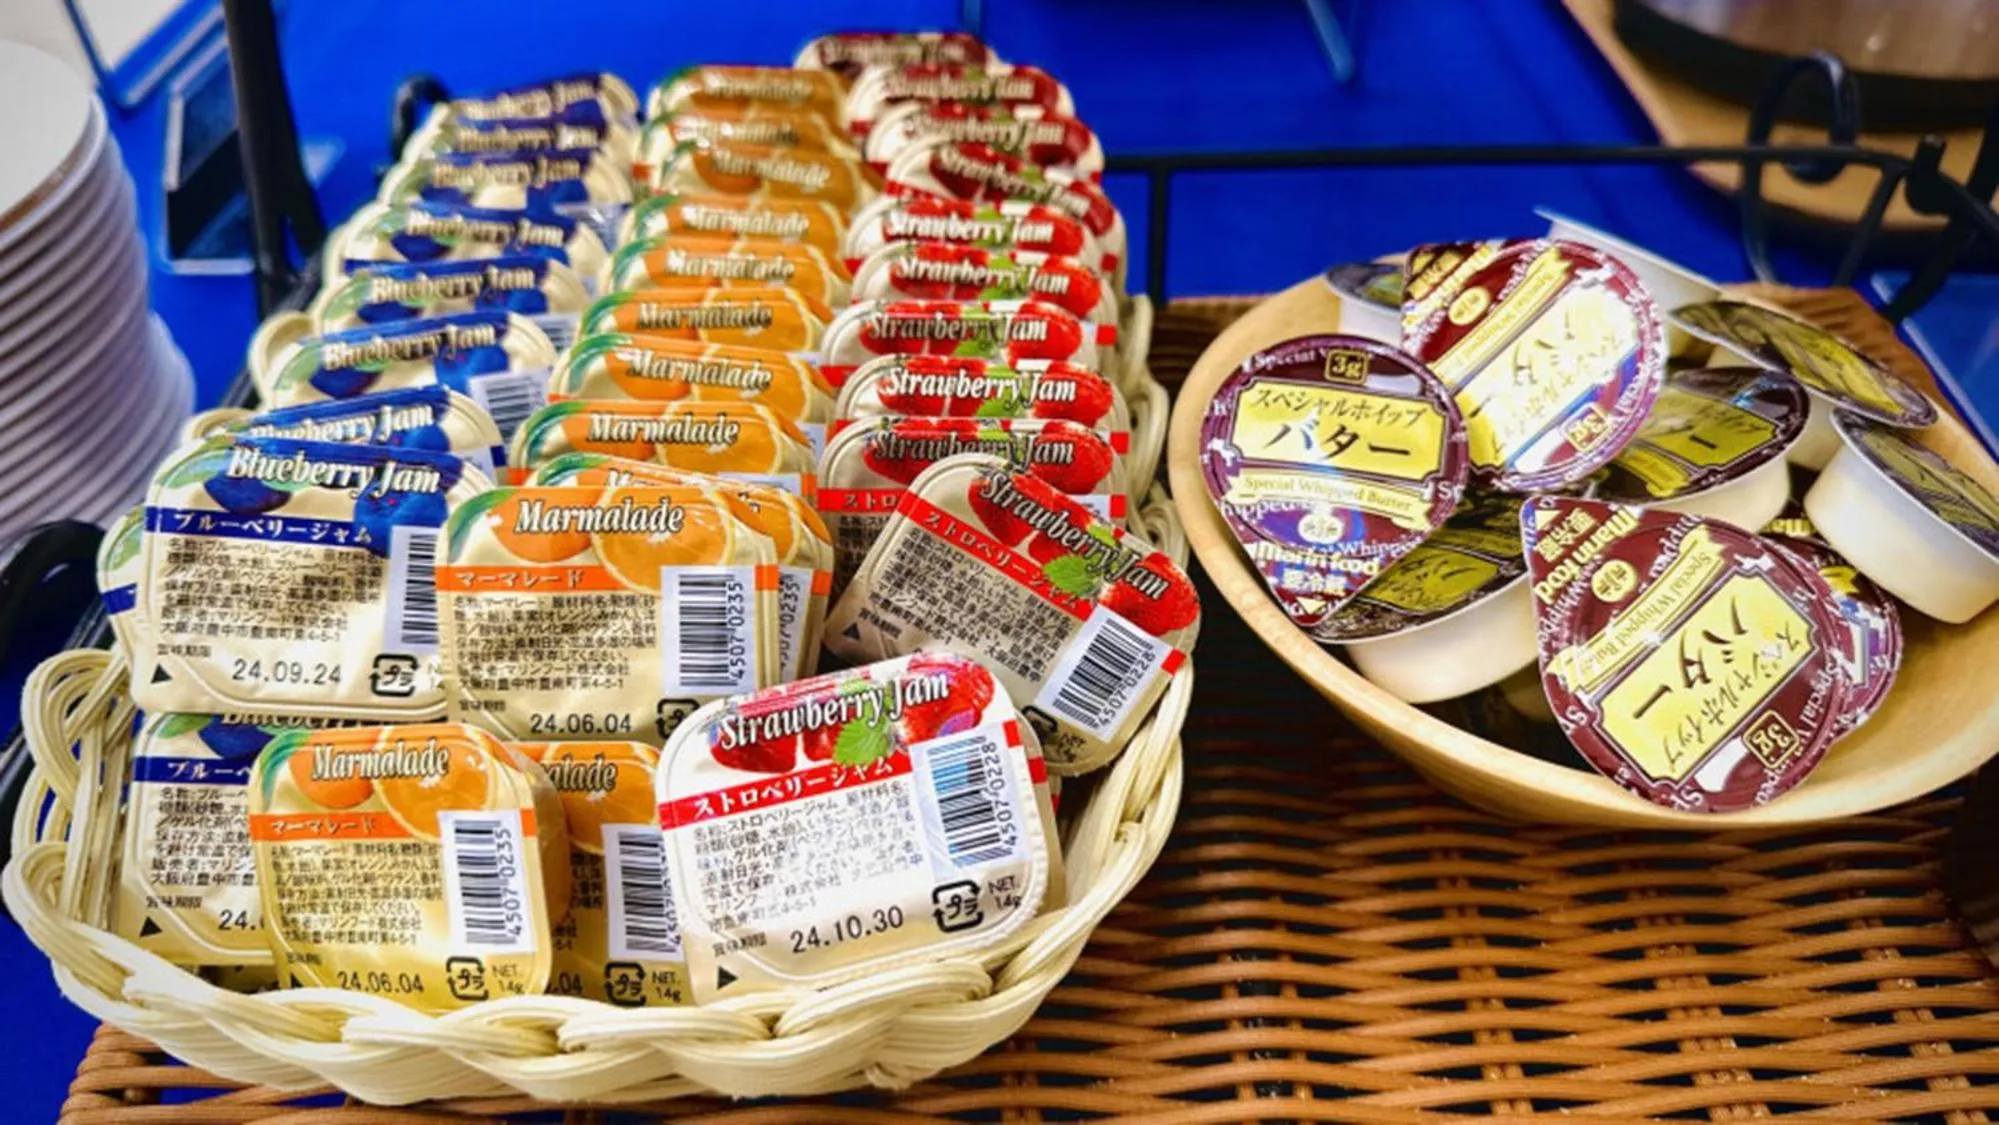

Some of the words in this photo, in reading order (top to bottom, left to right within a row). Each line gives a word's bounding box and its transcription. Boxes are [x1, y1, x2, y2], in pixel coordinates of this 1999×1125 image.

[692, 138, 831, 187] Marmalade
[513, 216, 565, 253] Jam
[679, 204, 811, 235] Marmalade
[886, 210, 1013, 248] Strawberry
[1009, 213, 1055, 249] Jam
[664, 248, 796, 281] Marmalade
[896, 252, 1028, 294] Strawberry
[1023, 263, 1070, 298] Jam
[368, 271, 484, 307] Blueberry
[480, 265, 536, 300] Jam
[635, 299, 773, 330] Marmalade
[868, 311, 1003, 350] Strawberry
[997, 313, 1048, 352] Jam
[321, 330, 444, 371] Blueberry
[440, 322, 497, 361] Jam
[1332, 355, 1362, 378] 3g
[622, 346, 773, 390] Marmalade
[885, 367, 1027, 410] Strawberry
[1022, 371, 1077, 411] Jam
[1251, 389, 1425, 426] スペシャルホイップ
[373, 403, 436, 443] Jam
[586, 410, 741, 445] Marmalade
[1263, 422, 1411, 460] バター
[1570, 413, 1604, 442] 3g
[1018, 430, 1075, 474] Jam
[223, 445, 376, 501] Blueberry
[370, 458, 444, 500] Jam
[1245, 475, 1297, 491] Special
[1299, 479, 1366, 503] Whipped
[1367, 487, 1412, 512] Butter
[173, 512, 373, 546] ブルーベリージャム
[513, 496, 685, 534] Marmalade
[979, 469, 1120, 575] Strawberry
[1109, 548, 1171, 600] Jam
[456, 570, 585, 589] マーマレード
[924, 511, 1080, 615] ストロベリージャム
[1330, 548, 1380, 576] food
[1534, 555, 1582, 605] food
[1669, 550, 1713, 596] Special
[1614, 588, 1673, 648] Whipped
[232, 658, 342, 684] 24.09.24
[1632, 594, 1749, 720] バター
[719, 688, 888, 751] Strawberry
[886, 672, 950, 721] Jam
[1663, 622, 1802, 774] スペシャルホイップ
[1799, 657, 1842, 732] Special
[529, 714, 632, 734] 24.06.04
[1751, 720, 1789, 757] 3g
[311, 737, 449, 782] Marmalade
[540, 752, 617, 793] alade
[693, 757, 894, 819] ストロベリージャム
[271, 816, 376, 835] マーマレード
[790, 906, 905, 954] 24.10.30
[337, 971, 425, 993] 24.06.04
